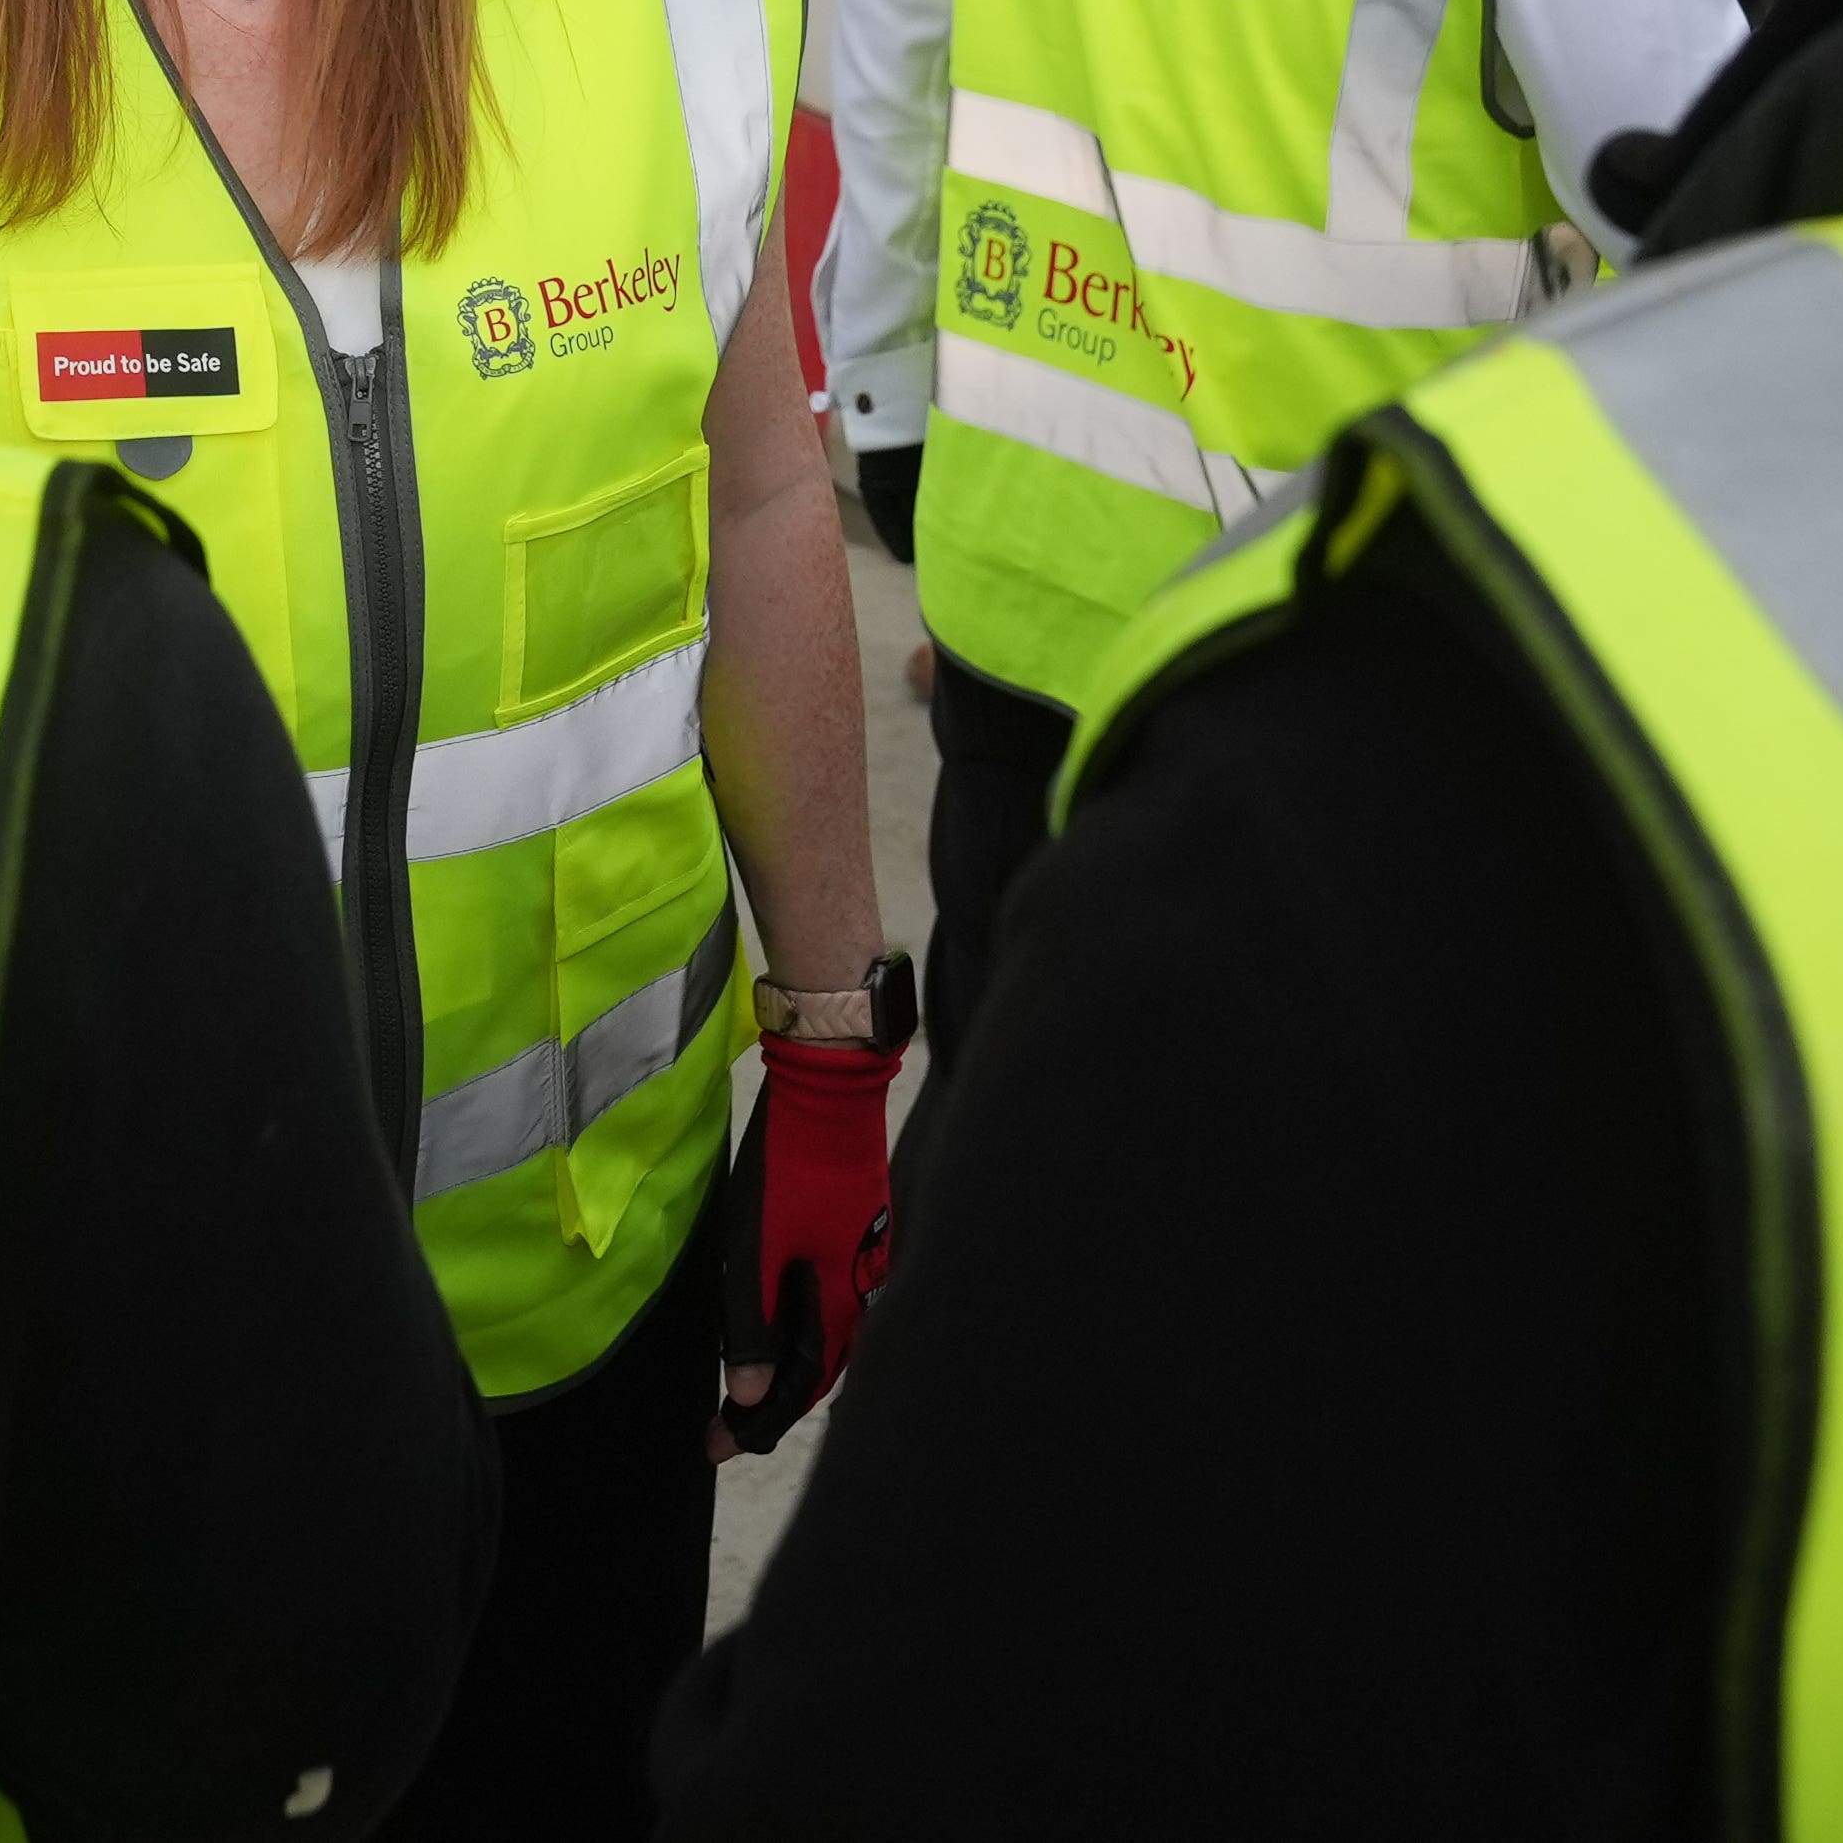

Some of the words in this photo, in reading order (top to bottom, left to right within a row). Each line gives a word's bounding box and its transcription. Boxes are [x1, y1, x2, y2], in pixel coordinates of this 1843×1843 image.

[538, 246, 680, 329] Berkeley
[550, 325, 614, 358] Group
[1037, 307, 1117, 366] Group
[53, 354, 116, 377] Proud
[120, 355, 142, 374] to
[146, 353, 172, 373] be
[177, 352, 221, 374] Safe
